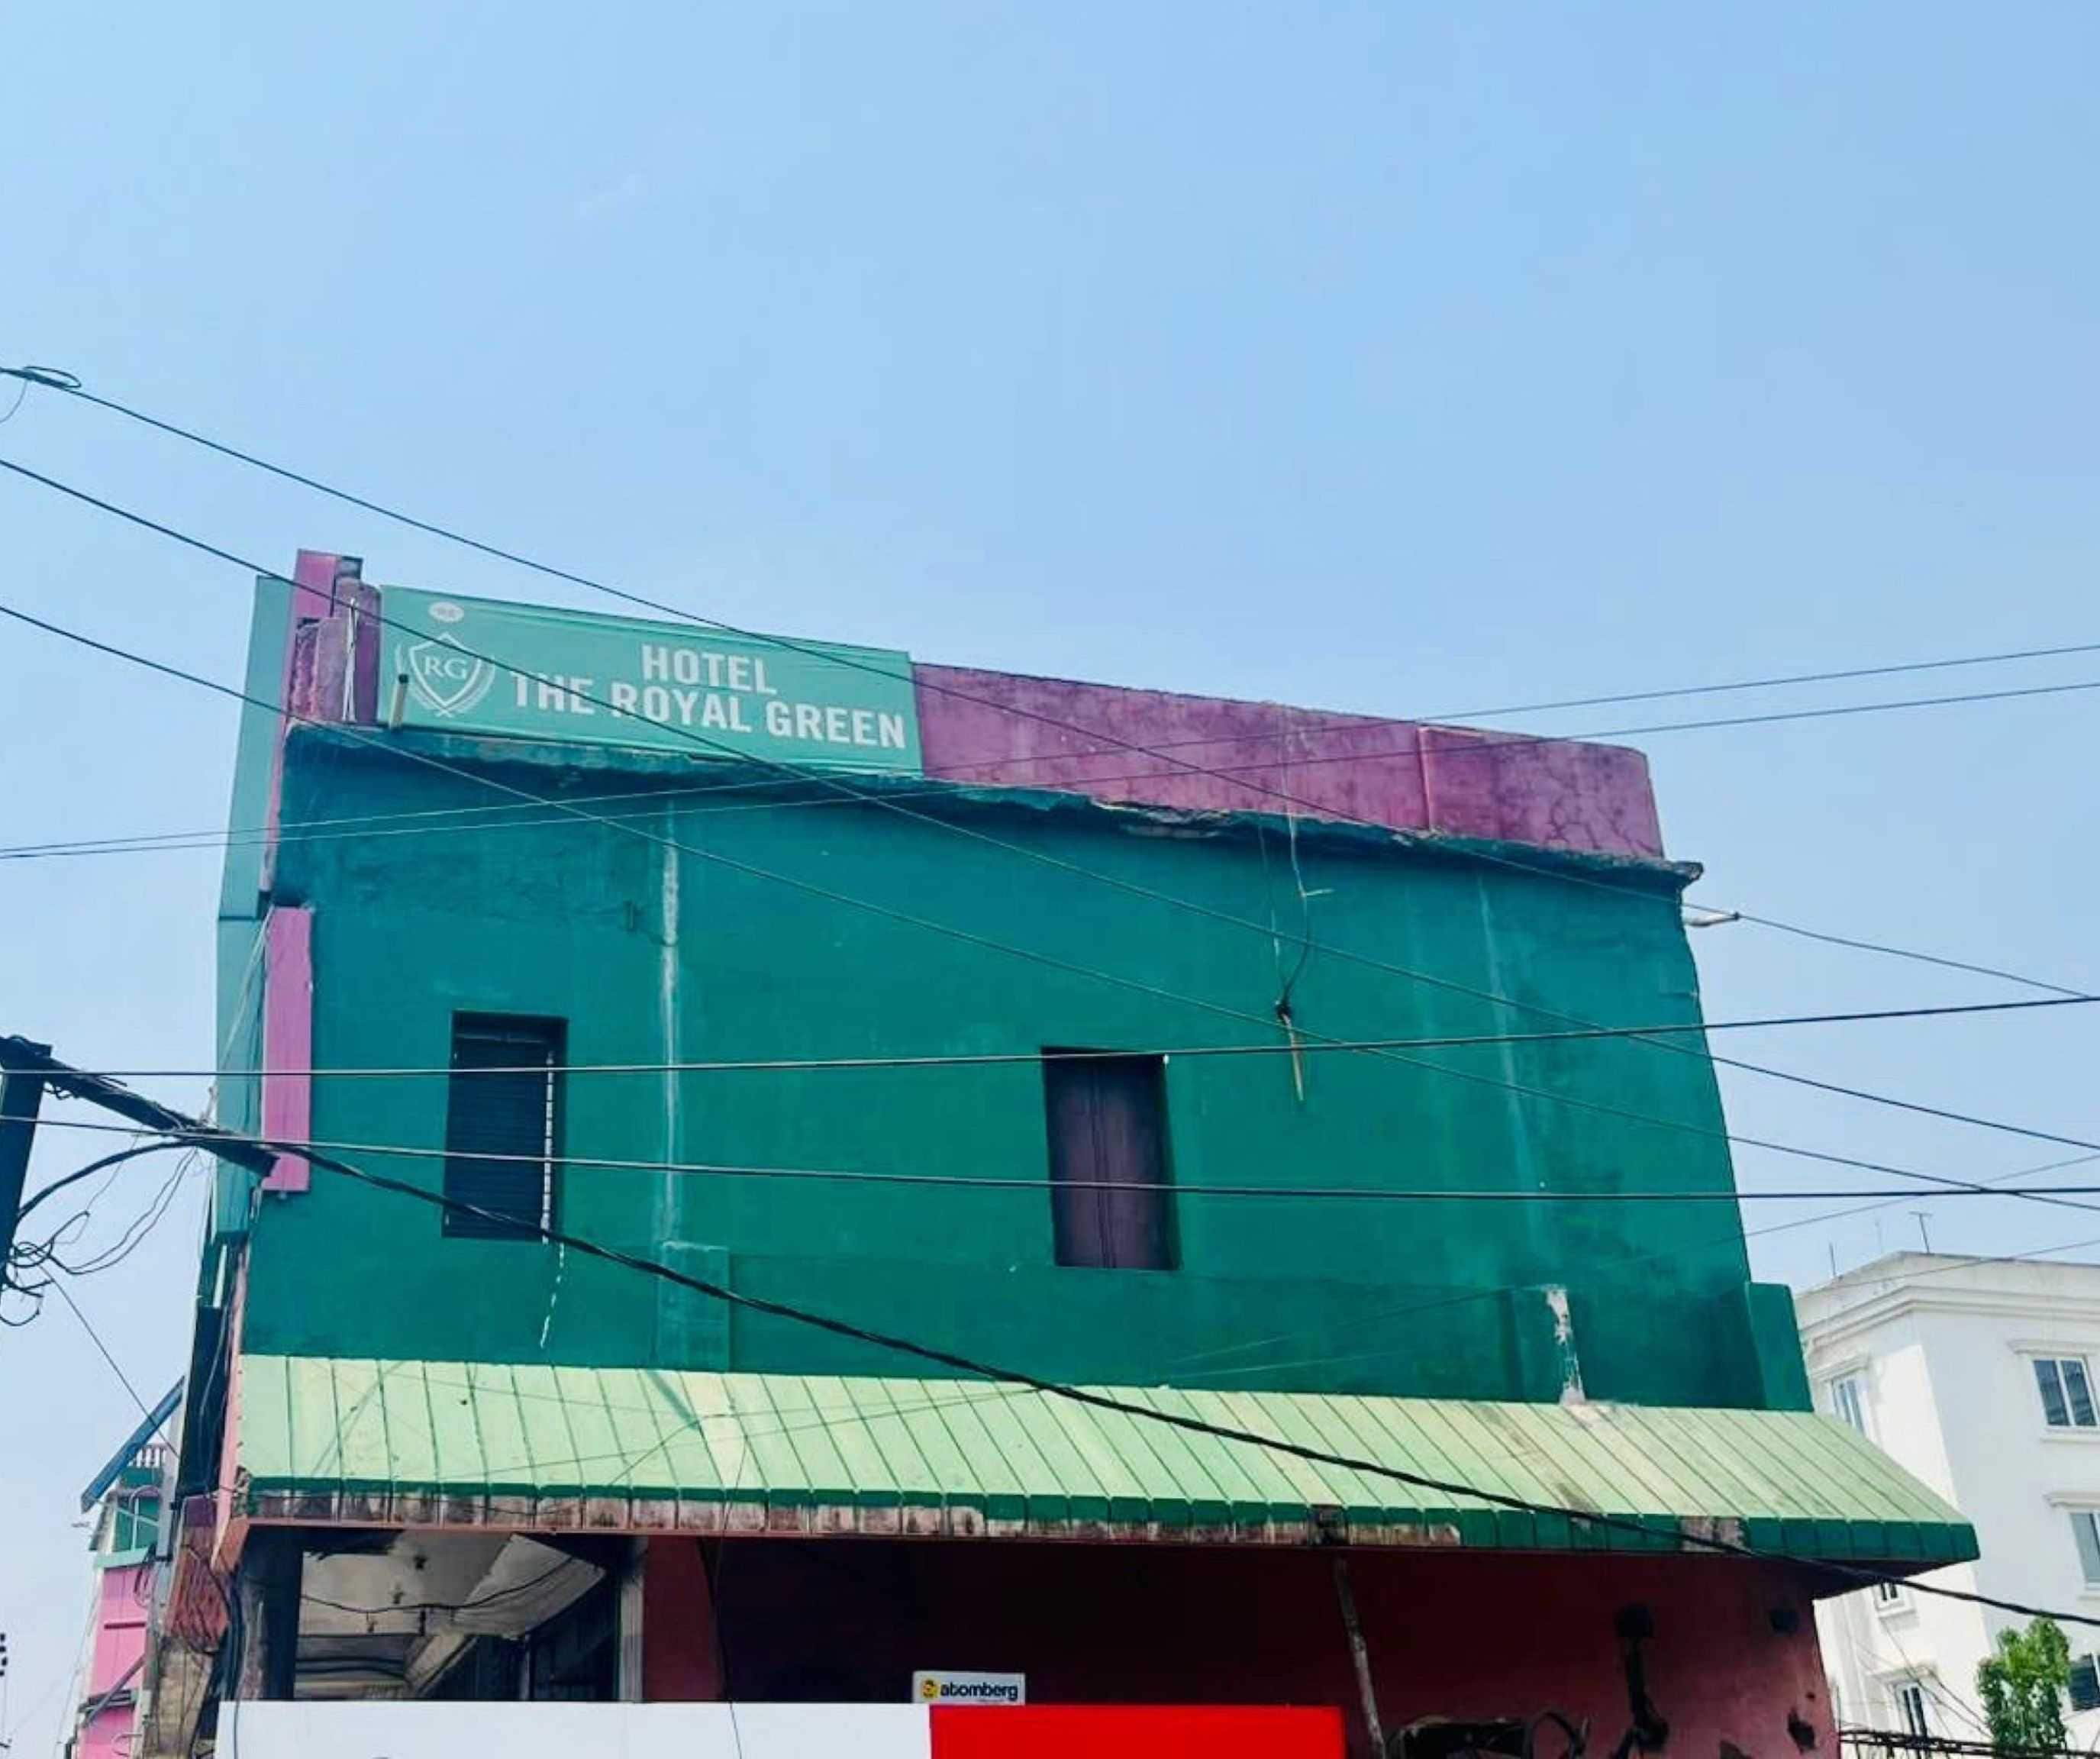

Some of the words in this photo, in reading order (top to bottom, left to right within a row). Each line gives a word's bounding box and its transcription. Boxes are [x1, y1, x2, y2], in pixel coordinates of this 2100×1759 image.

[424, 656, 467, 679] RG
[642, 644, 777, 696] HOTEL
[511, 670, 593, 713] THE
[610, 680, 752, 732] ROYAL
[766, 700, 905, 748] GREEN
[940, 1682, 1018, 1702] atomberg
